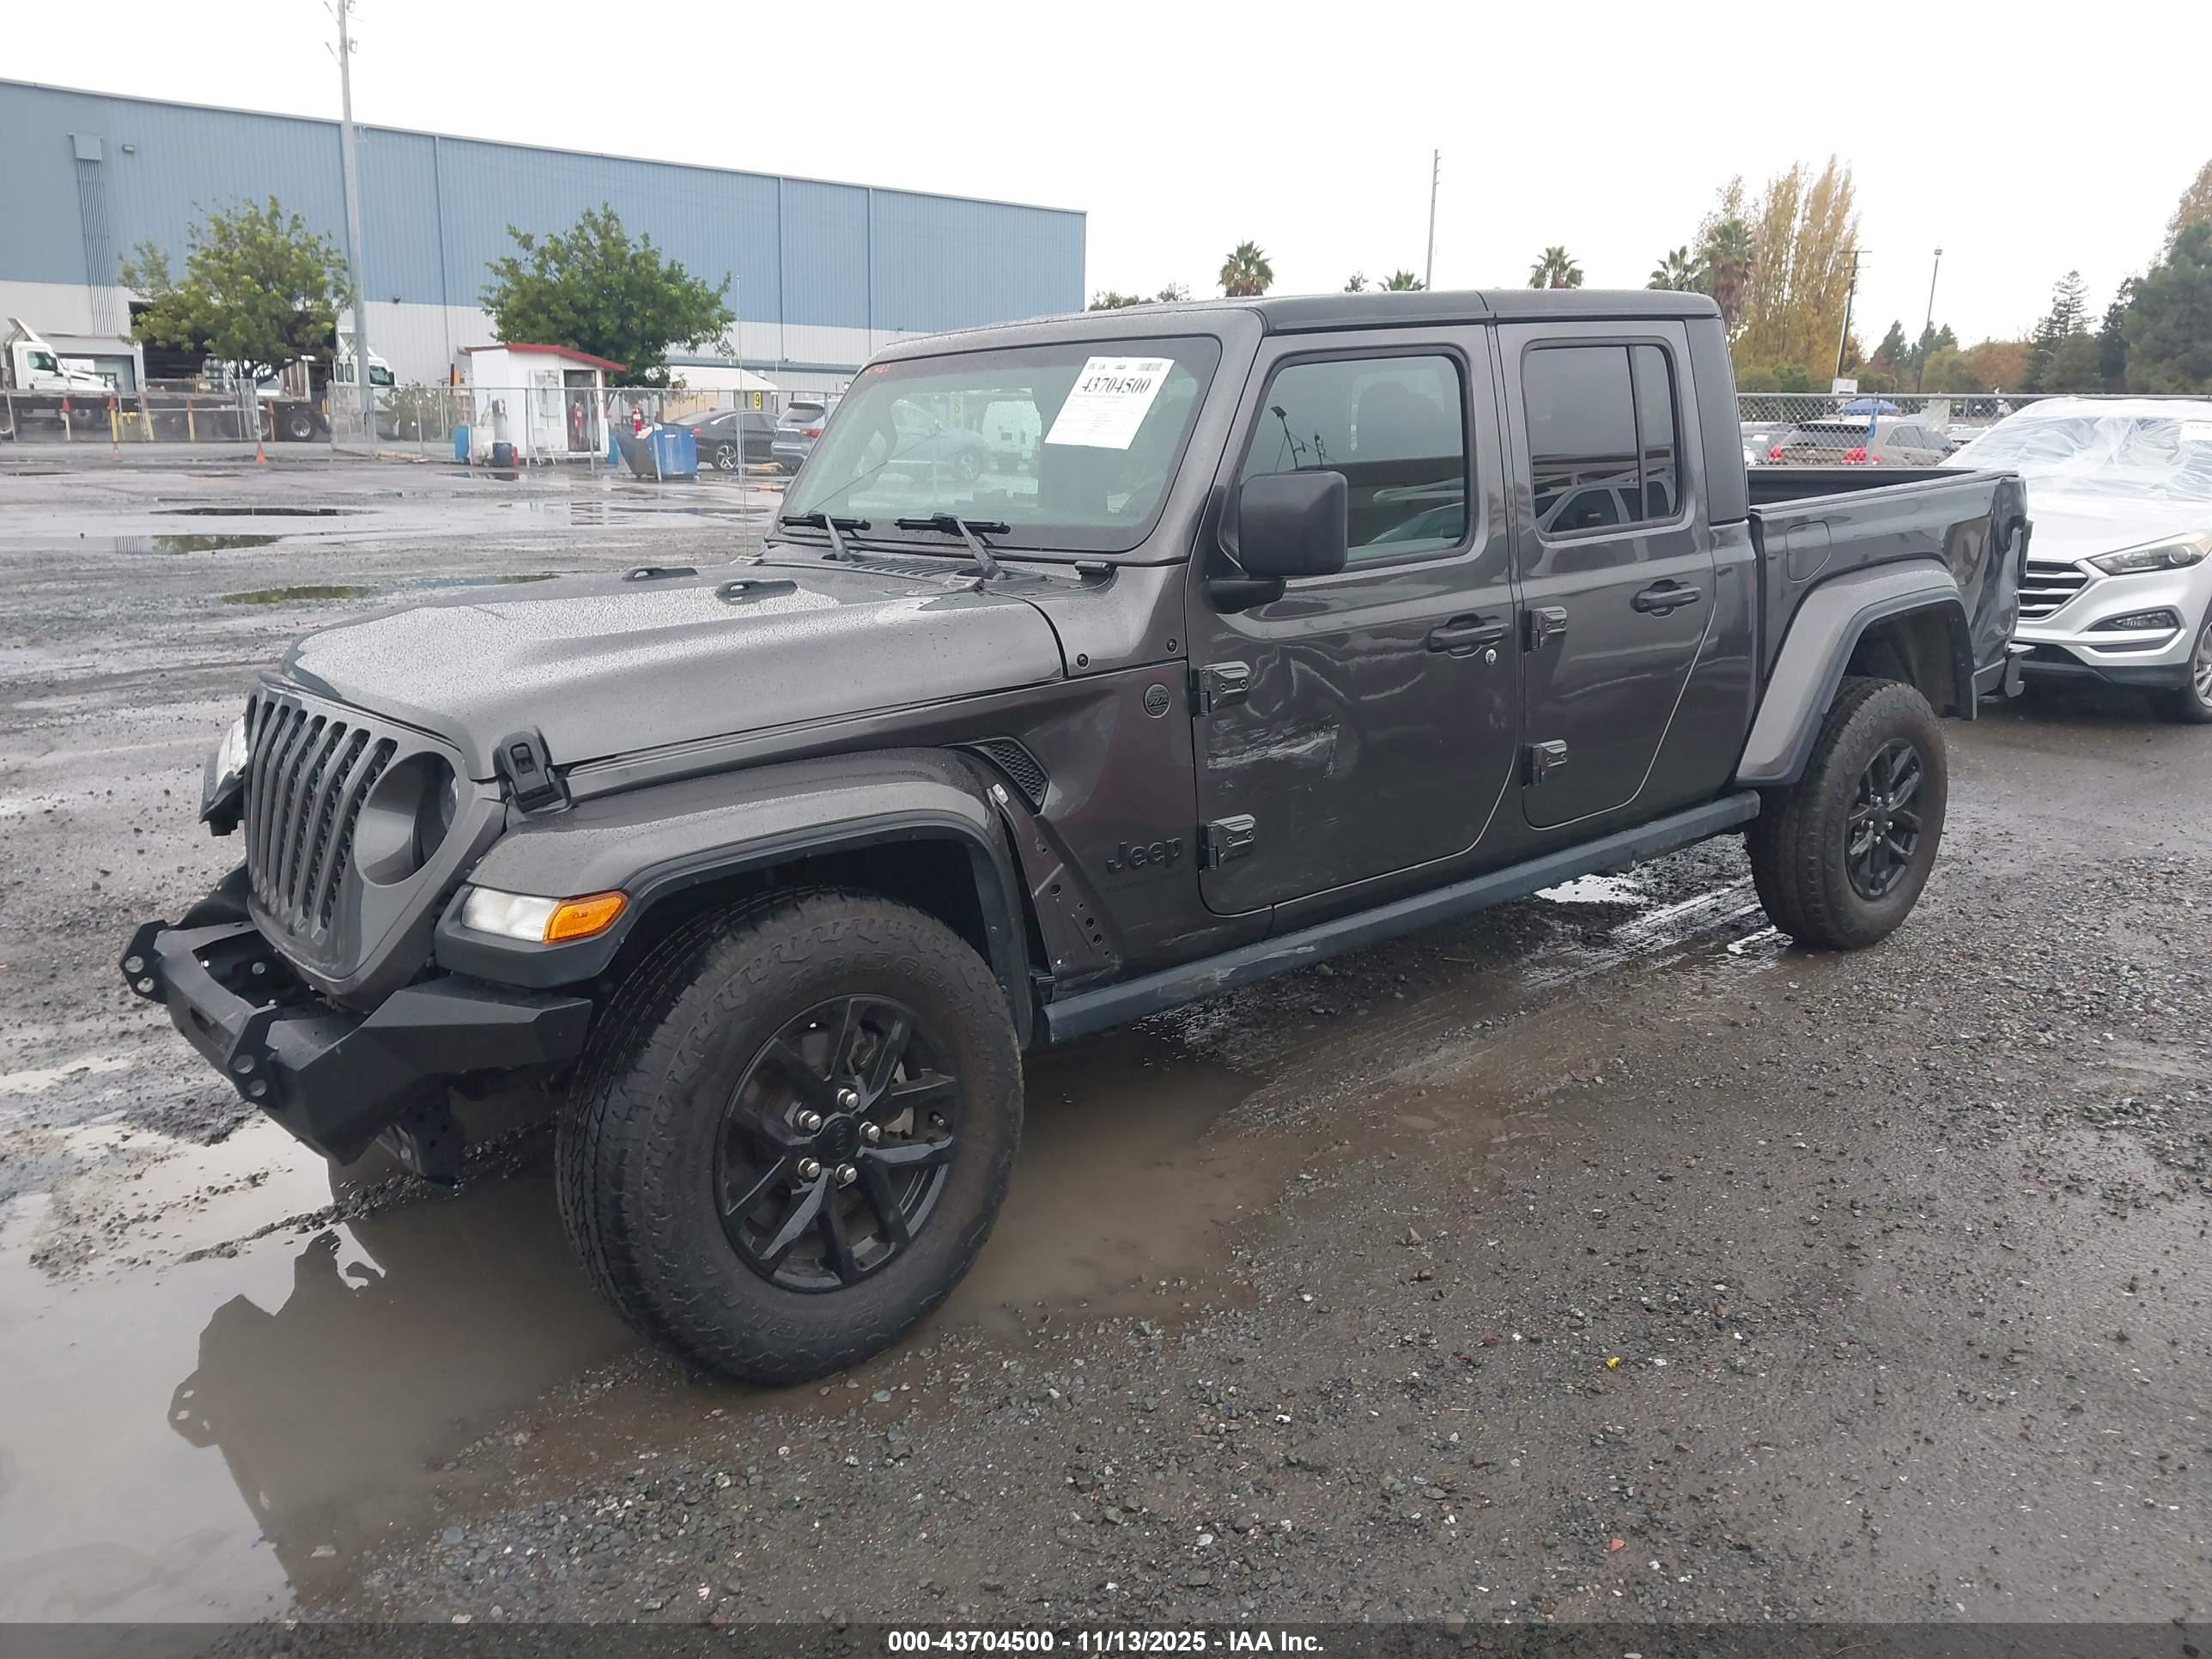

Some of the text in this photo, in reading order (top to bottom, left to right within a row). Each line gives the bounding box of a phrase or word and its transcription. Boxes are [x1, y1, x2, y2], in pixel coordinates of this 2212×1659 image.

[1082, 377, 1152, 394] 43704500
[755, 392, 761, 407] 9
[1106, 837, 1182, 873] Jeep
